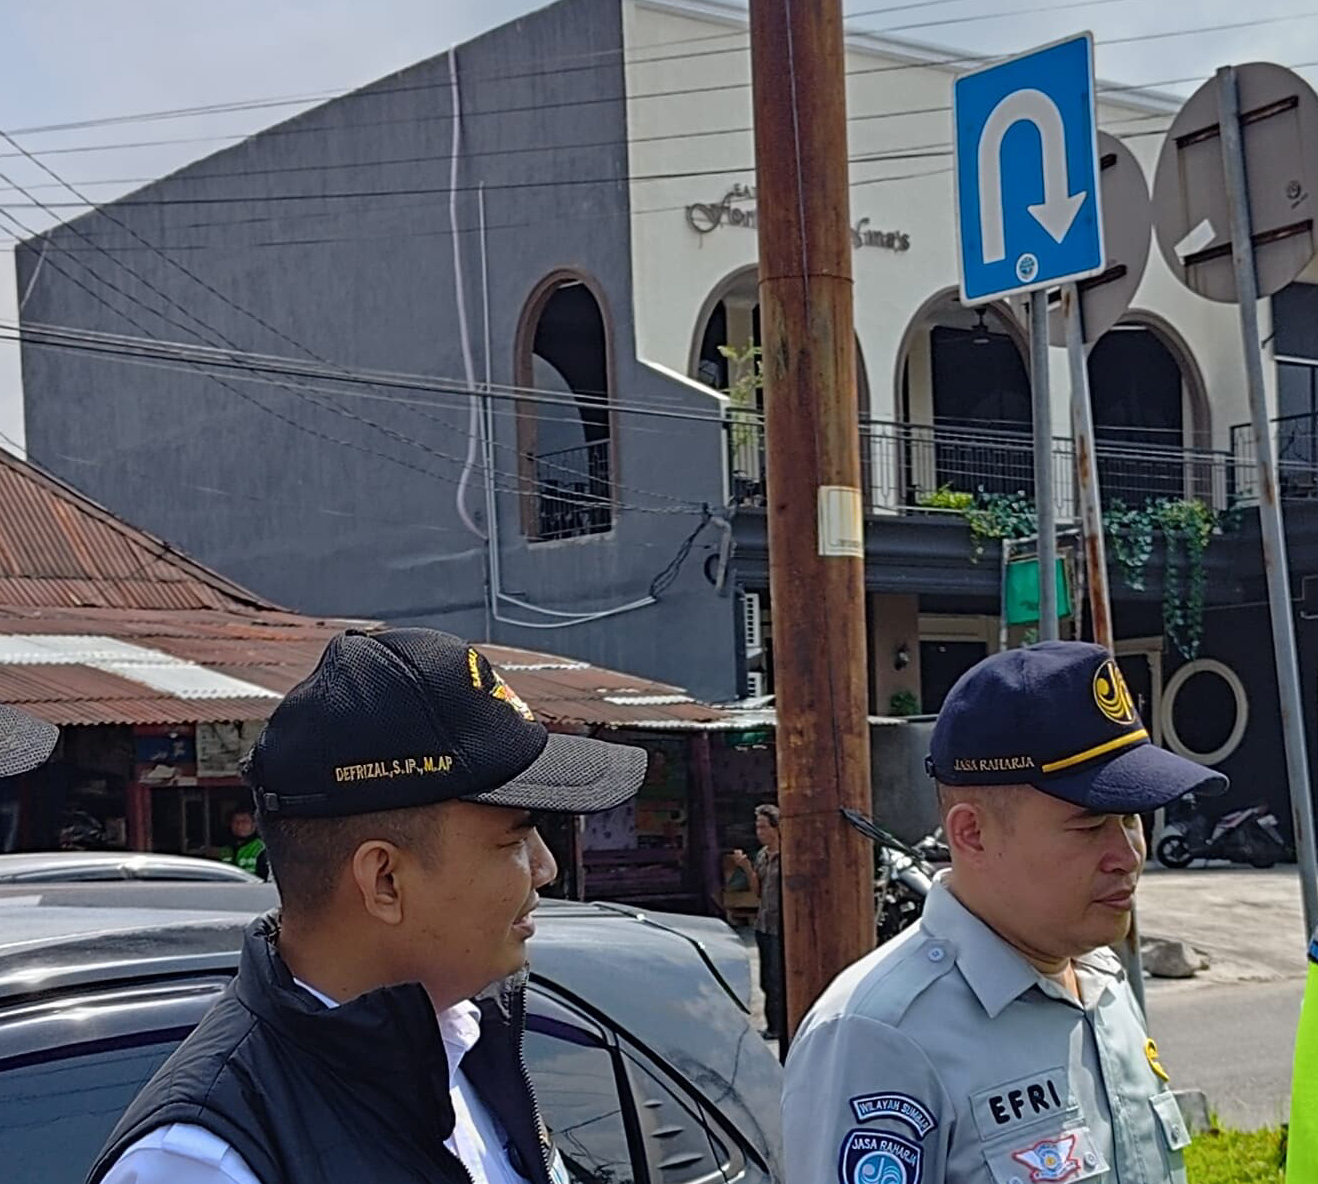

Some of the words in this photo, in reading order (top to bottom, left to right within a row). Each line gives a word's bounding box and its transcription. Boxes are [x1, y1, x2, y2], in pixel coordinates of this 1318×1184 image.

[953, 759, 978, 771] JASA
[979, 756, 1035, 771] RAHARJA
[859, 1100, 899, 1114] WILAYAH
[900, 1102, 930, 1130] SUMBAR
[988, 1079, 1061, 1125] EFRI
[851, 1138, 877, 1150] JASA
[879, 1140, 917, 1168] RAHARJA
